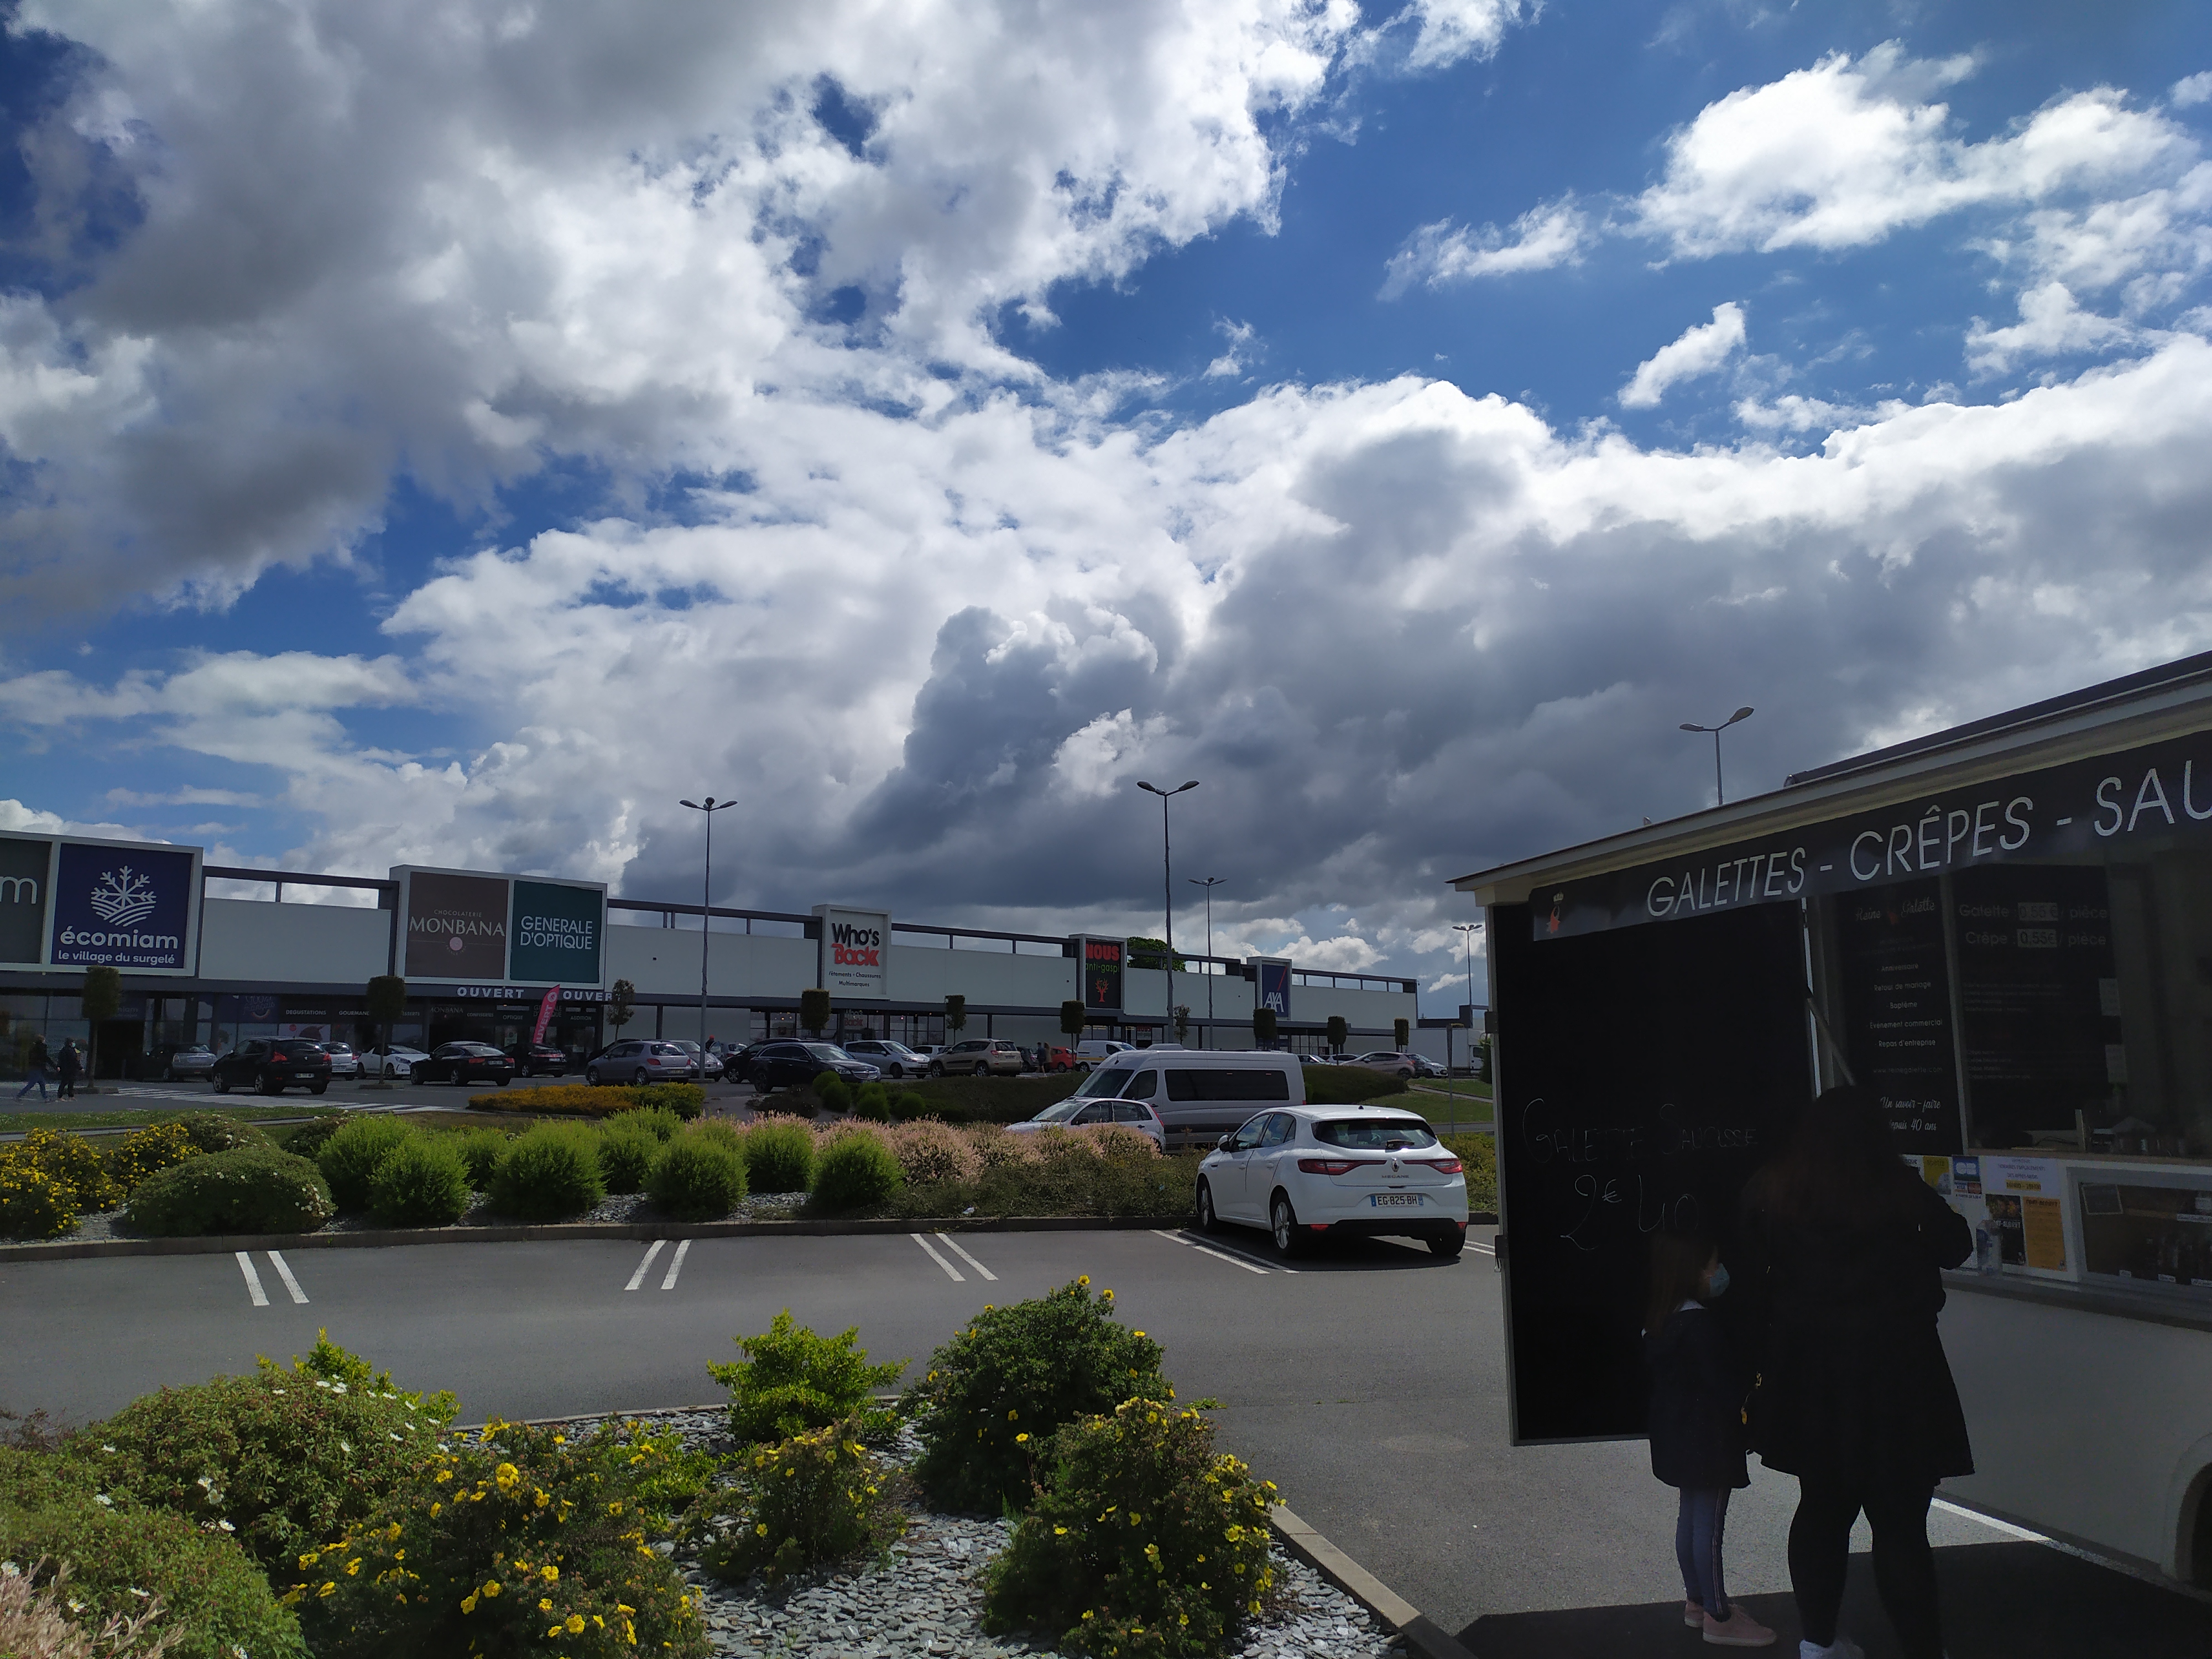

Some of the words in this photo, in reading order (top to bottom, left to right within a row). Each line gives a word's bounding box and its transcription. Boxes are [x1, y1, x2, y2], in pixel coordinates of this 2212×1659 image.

[1647, 847, 1807, 916] GALETTES
[1850, 797, 2034, 880] CRÊPES
[434, 909, 482, 917] CHOCOLATERIE
[1855, 907, 1882, 921] Reine
[1901, 896, 1936, 918] Galette
[1959, 904, 2010, 917] Galette
[2069, 905, 2107, 920] pièce
[408, 916, 505, 937] MONBANA
[521, 915, 593, 935] GENERALE
[60, 926, 178, 949] écomiam
[520, 931, 592, 950] D'OPTIQUE
[832, 922, 880, 947] Who's
[1965, 931, 2008, 946] Crêpe
[2068, 932, 2106, 947] pièce
[58, 950, 70, 960] le
[72, 951, 113, 963] village
[115, 952, 130, 962] du
[133, 954, 175, 966] surgelé
[831, 943, 879, 966] Back
[1086, 943, 1120, 961] NOUS
[1086, 962, 1120, 974] anti-gaspi
[1881, 963, 1919, 972] Anniversaire
[457, 987, 524, 998] OUVERT
[1905, 981, 1931, 989] mariage
[1263, 992, 1285, 1013] AXA
[1890, 1001, 1917, 1009] Baptême
[1905, 1018, 1943, 1027] commercial
[1899, 1039, 1936, 1048] d'entreprise
[1880, 1096, 1893, 1109] Un
[1911, 1118, 1922, 1131] 40
[1924, 1121, 1937, 1131] ans
[1378, 1196, 1417, 1206] EG-825-BH
